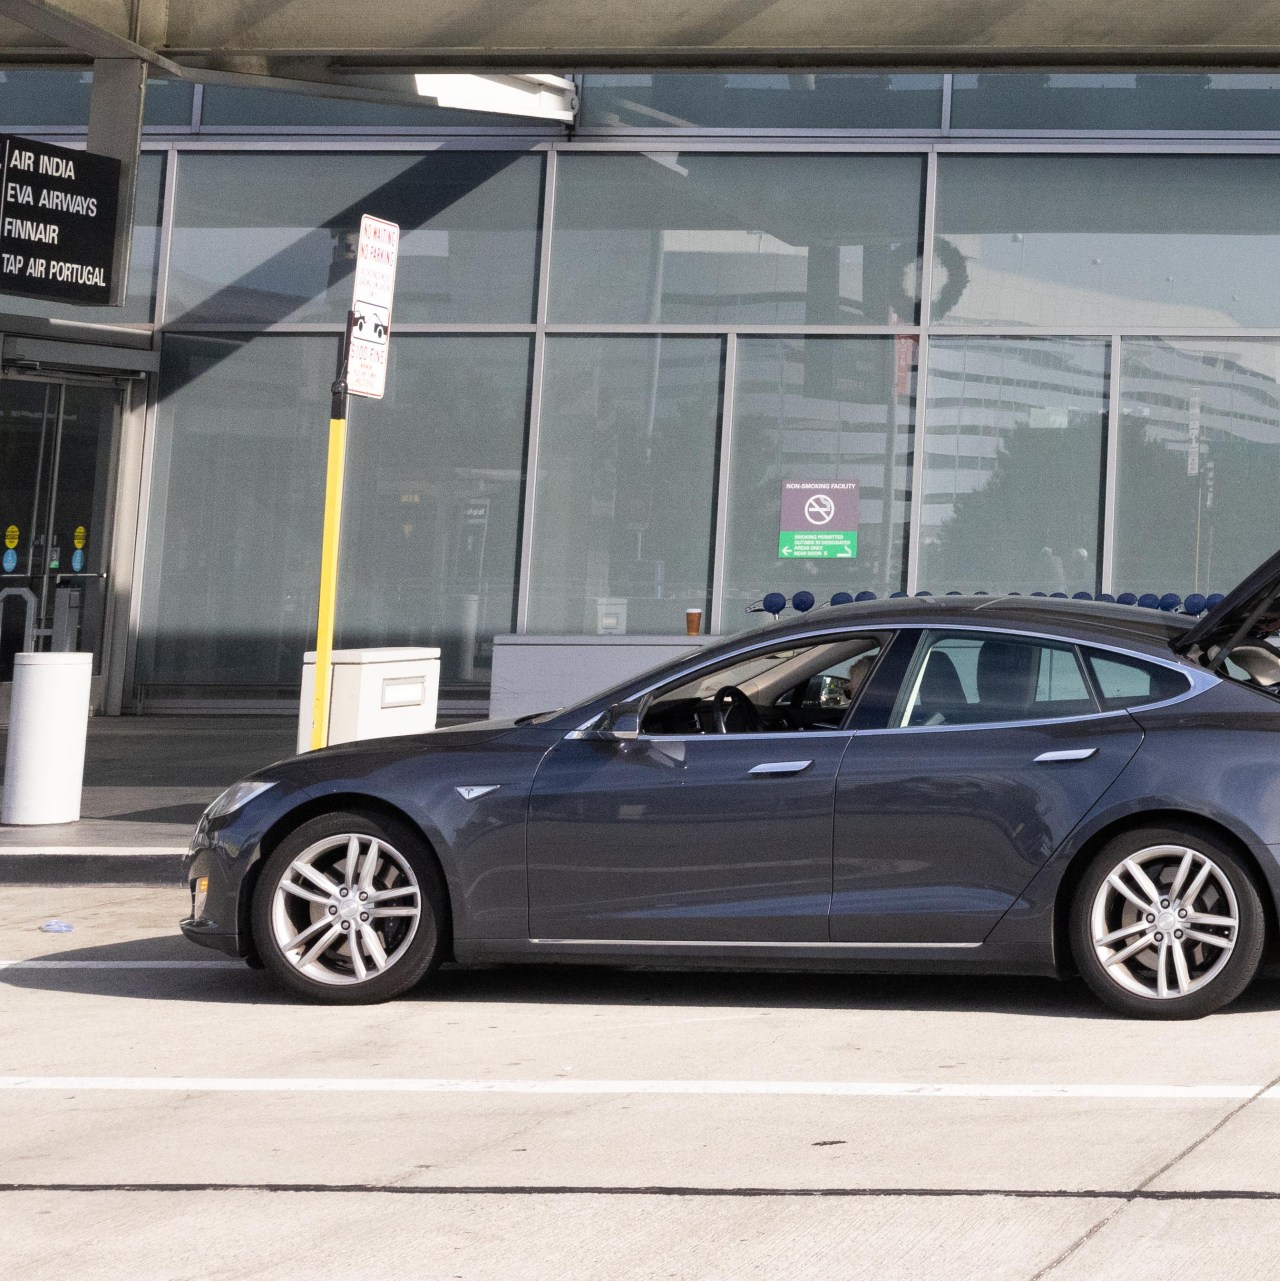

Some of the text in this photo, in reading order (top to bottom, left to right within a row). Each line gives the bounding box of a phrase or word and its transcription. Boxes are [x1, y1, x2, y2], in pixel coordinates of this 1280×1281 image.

[10, 150, 75, 180] AIR INDIA
[7, 182, 97, 217] EVA AIRWAYS
[4, 217, 59, 245] FINNAIR
[364, 223, 396, 245] NO WAITING
[2, 253, 106, 286] TAP AIR PORTUGAL
[361, 243, 395, 267] NO PARKING
